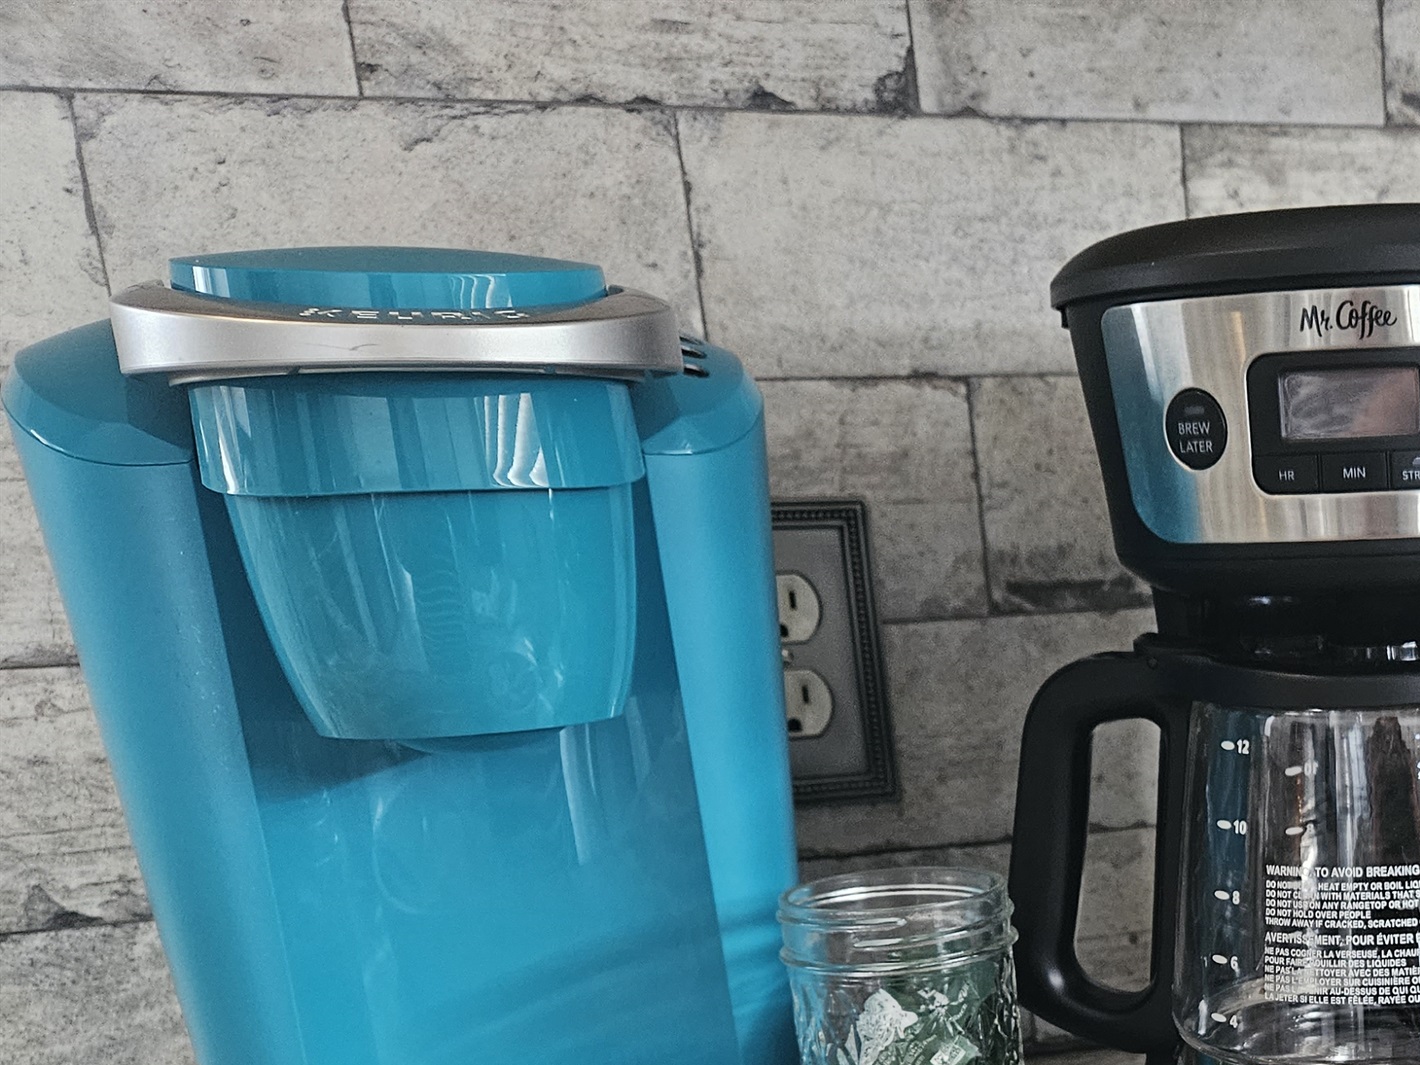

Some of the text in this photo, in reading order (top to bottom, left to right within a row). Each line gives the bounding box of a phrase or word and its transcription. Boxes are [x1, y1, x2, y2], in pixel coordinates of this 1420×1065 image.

[1300, 300, 1397, 340] Mr. Coffee
[1178, 422, 1210, 437] BREW
[1180, 438, 1213, 453] LATER
[1279, 469, 1294, 481] HR
[1343, 466, 1366, 479] MIN
[1237, 739, 1249, 754] 12
[1233, 819, 1246, 835] 10
[1315, 867, 1328, 877] TO
[1331, 867, 1363, 877] AVOID
[1366, 865, 1420, 878] BREAKING
[1318, 883, 1339, 891] HEAT
[1341, 883, 1368, 891] EMPTY
[1370, 882, 1382, 890] OR
[1384, 881, 1403, 890] BOIL
[1232, 891, 1240, 904] 8
[1321, 892, 1341, 900] WITH
[1343, 892, 1390, 900] MATERIALS
[1393, 890, 1413, 899] THAT
[1322, 901, 1339, 909] ANY
[1341, 901, 1386, 909] RANGETOP
[1266, 908, 1371, 919] DO NOT HOLD OVER PEOPLE
[1368, 918, 1418, 928] SCRATCHED
[1346, 935, 1374, 945] POUR
[1376, 932, 1414, 945] ÉVITER
[1230, 956, 1238, 970] 6
[1367, 959, 1406, 968] LIQUIDES
[1230, 1015, 1237, 1028] 4
